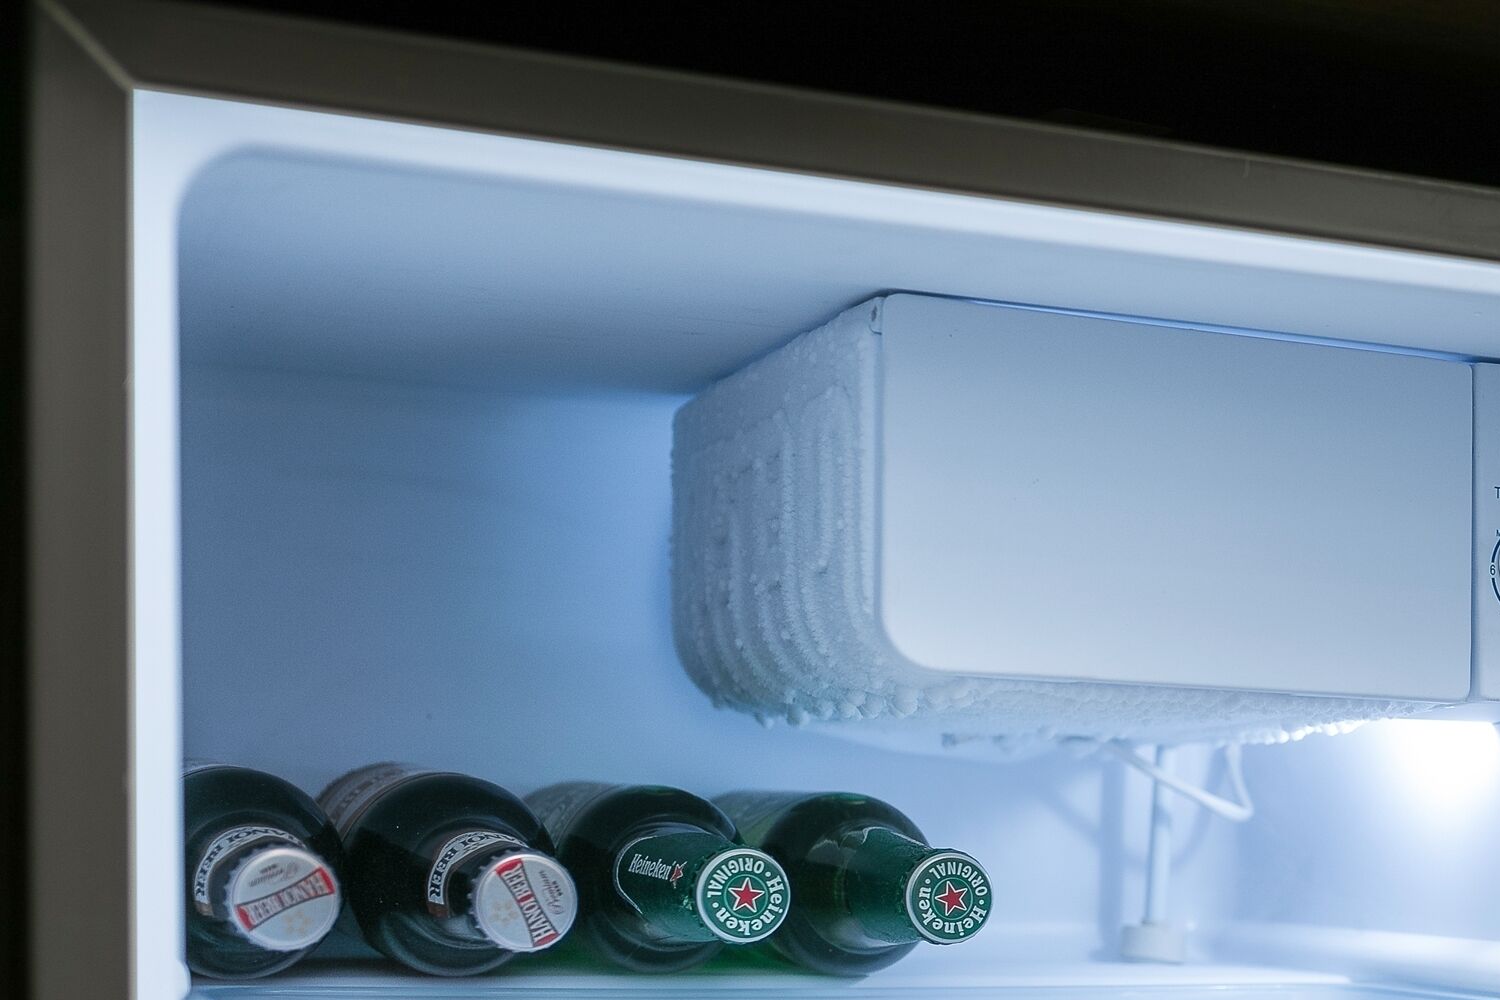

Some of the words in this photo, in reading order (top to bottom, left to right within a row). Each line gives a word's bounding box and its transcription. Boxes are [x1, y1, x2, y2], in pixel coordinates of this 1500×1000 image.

[1490, 564, 1496, 576] 6
[429, 847, 457, 898] BEER
[500, 862, 528, 899] BEER
[628, 853, 671, 881] Heineken
[706, 858, 764, 898] ORIGINAL
[928, 862, 988, 896] ORIGINAL
[520, 898, 552, 941] HANOI
[716, 875, 785, 936] Heineken
[918, 887, 987, 936] Heineken
